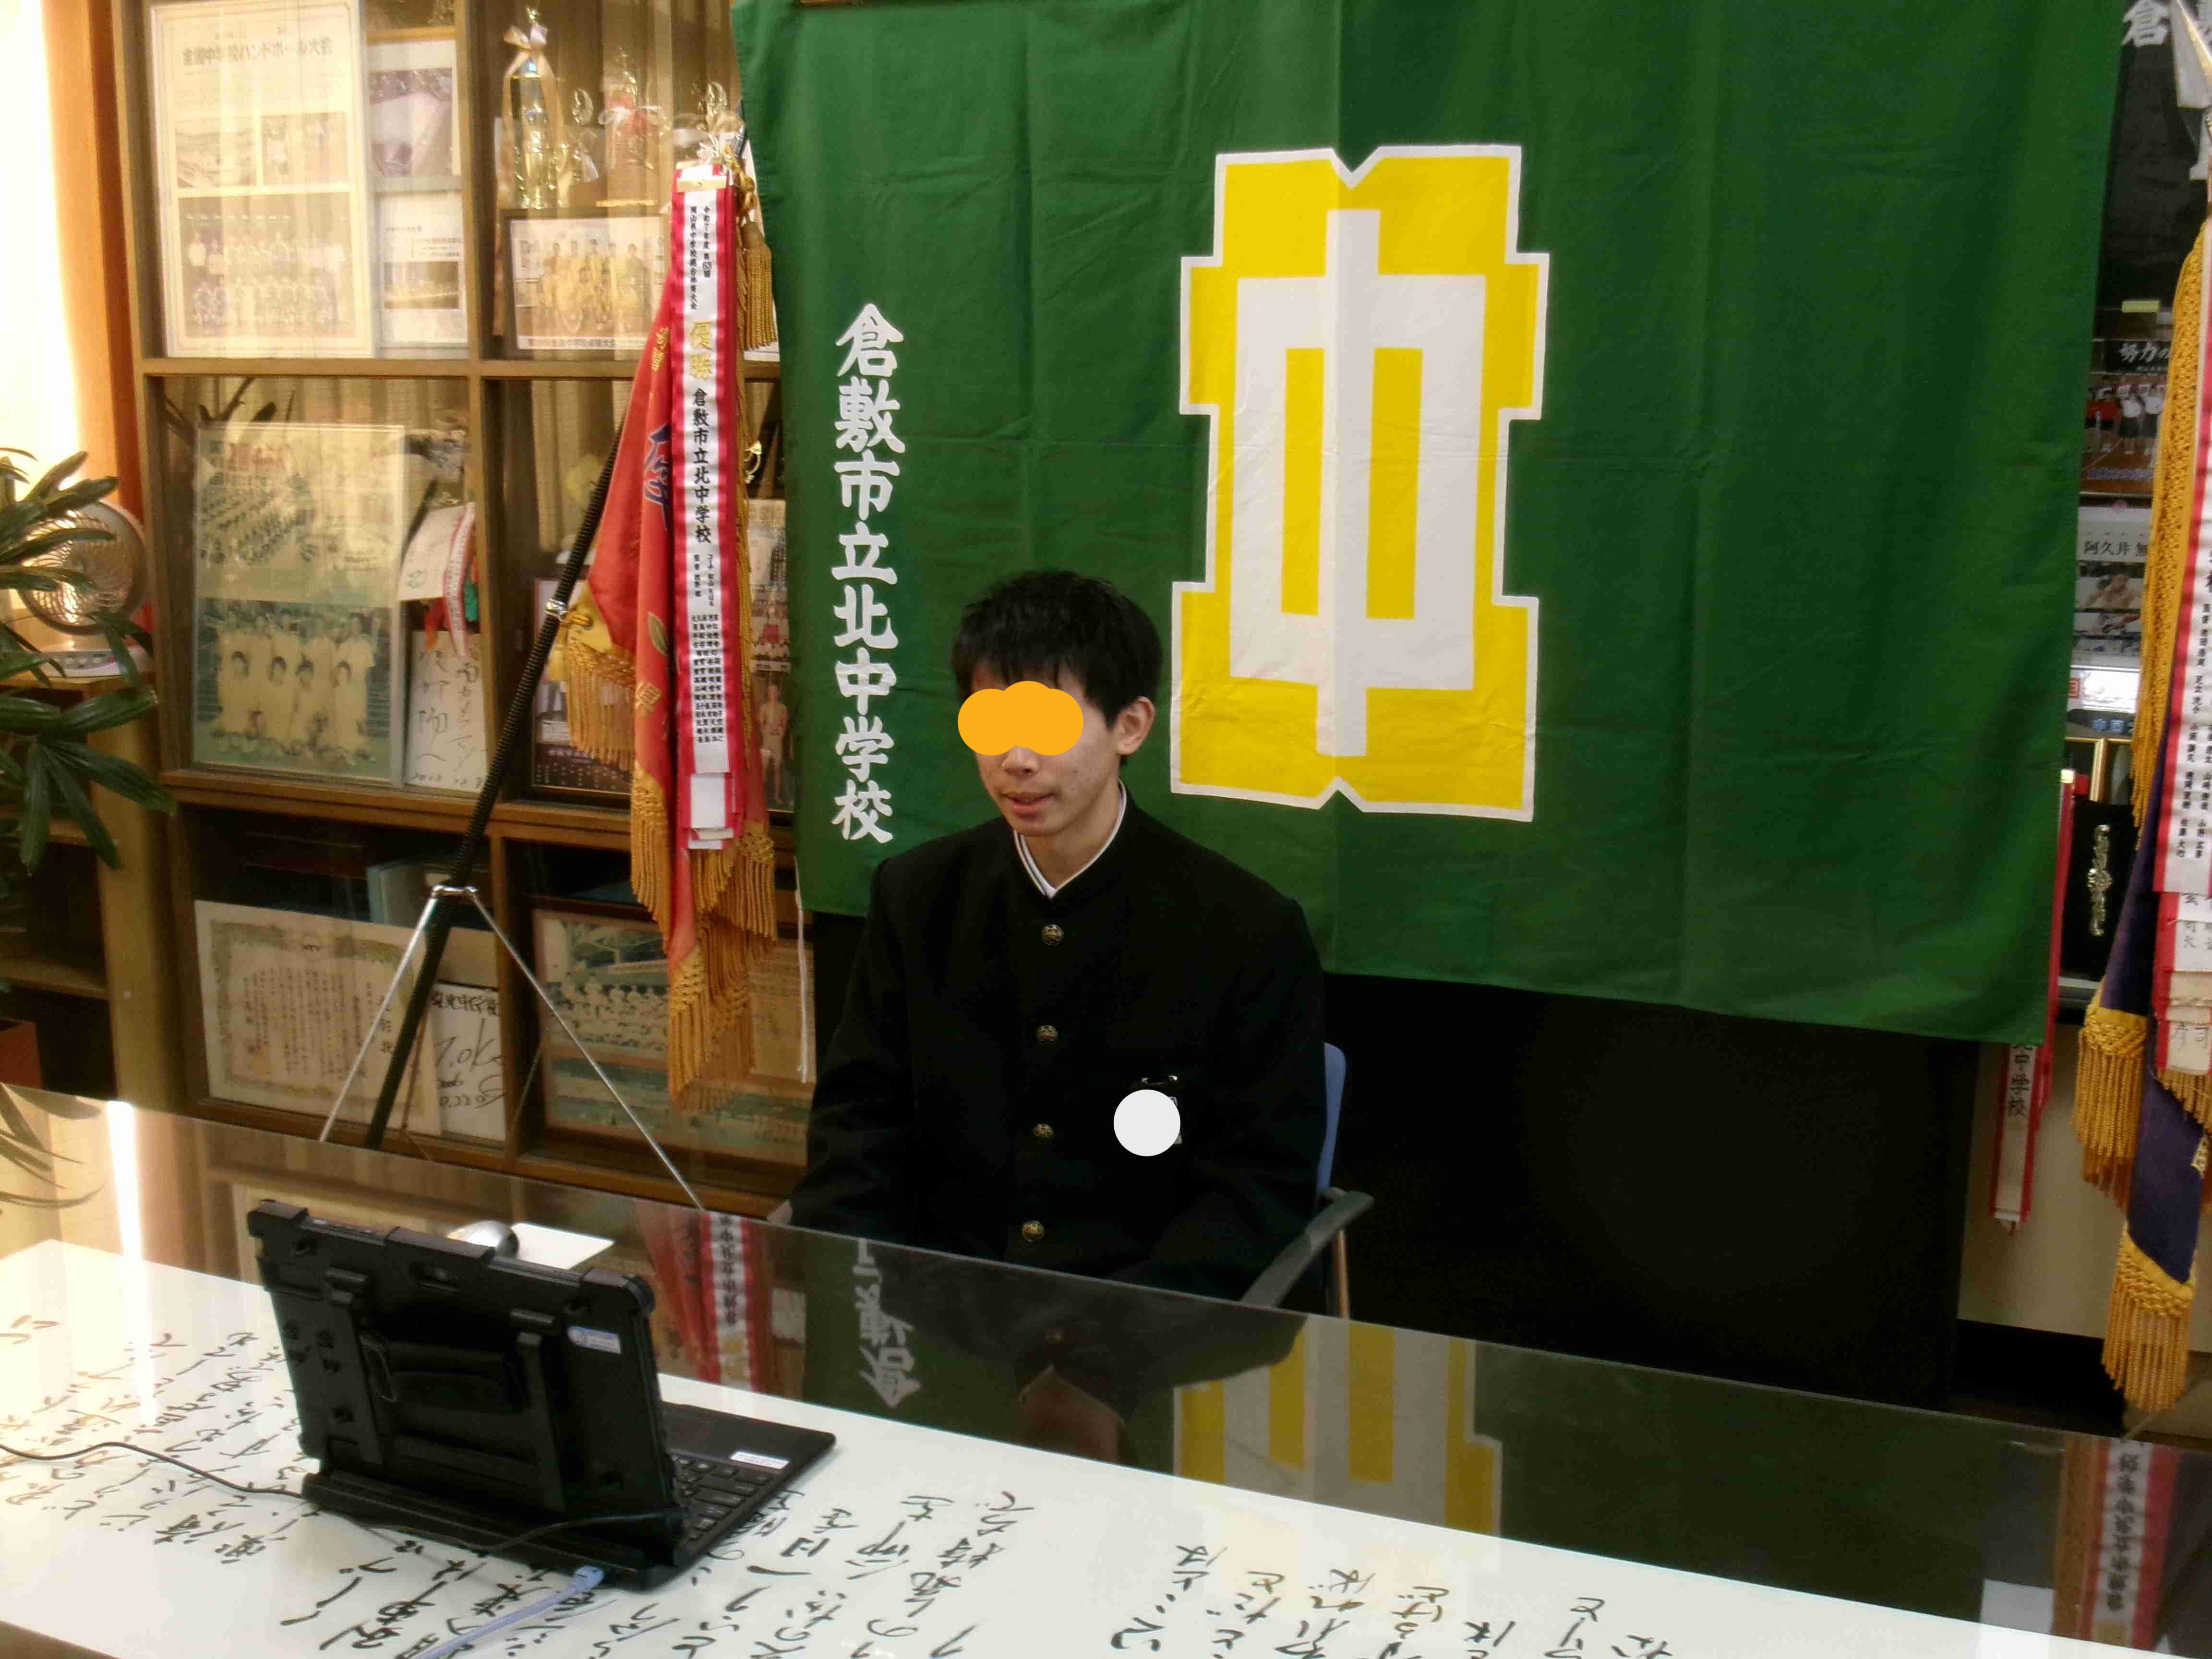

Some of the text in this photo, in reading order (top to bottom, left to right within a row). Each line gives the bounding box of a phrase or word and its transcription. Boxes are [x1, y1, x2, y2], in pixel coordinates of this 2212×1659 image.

[692, 387, 712, 544] 倉敷市立北中学校
[831, 303, 905, 843] 倉敷市立北中学校
[2007, 1046, 2032, 1117] 中学校
